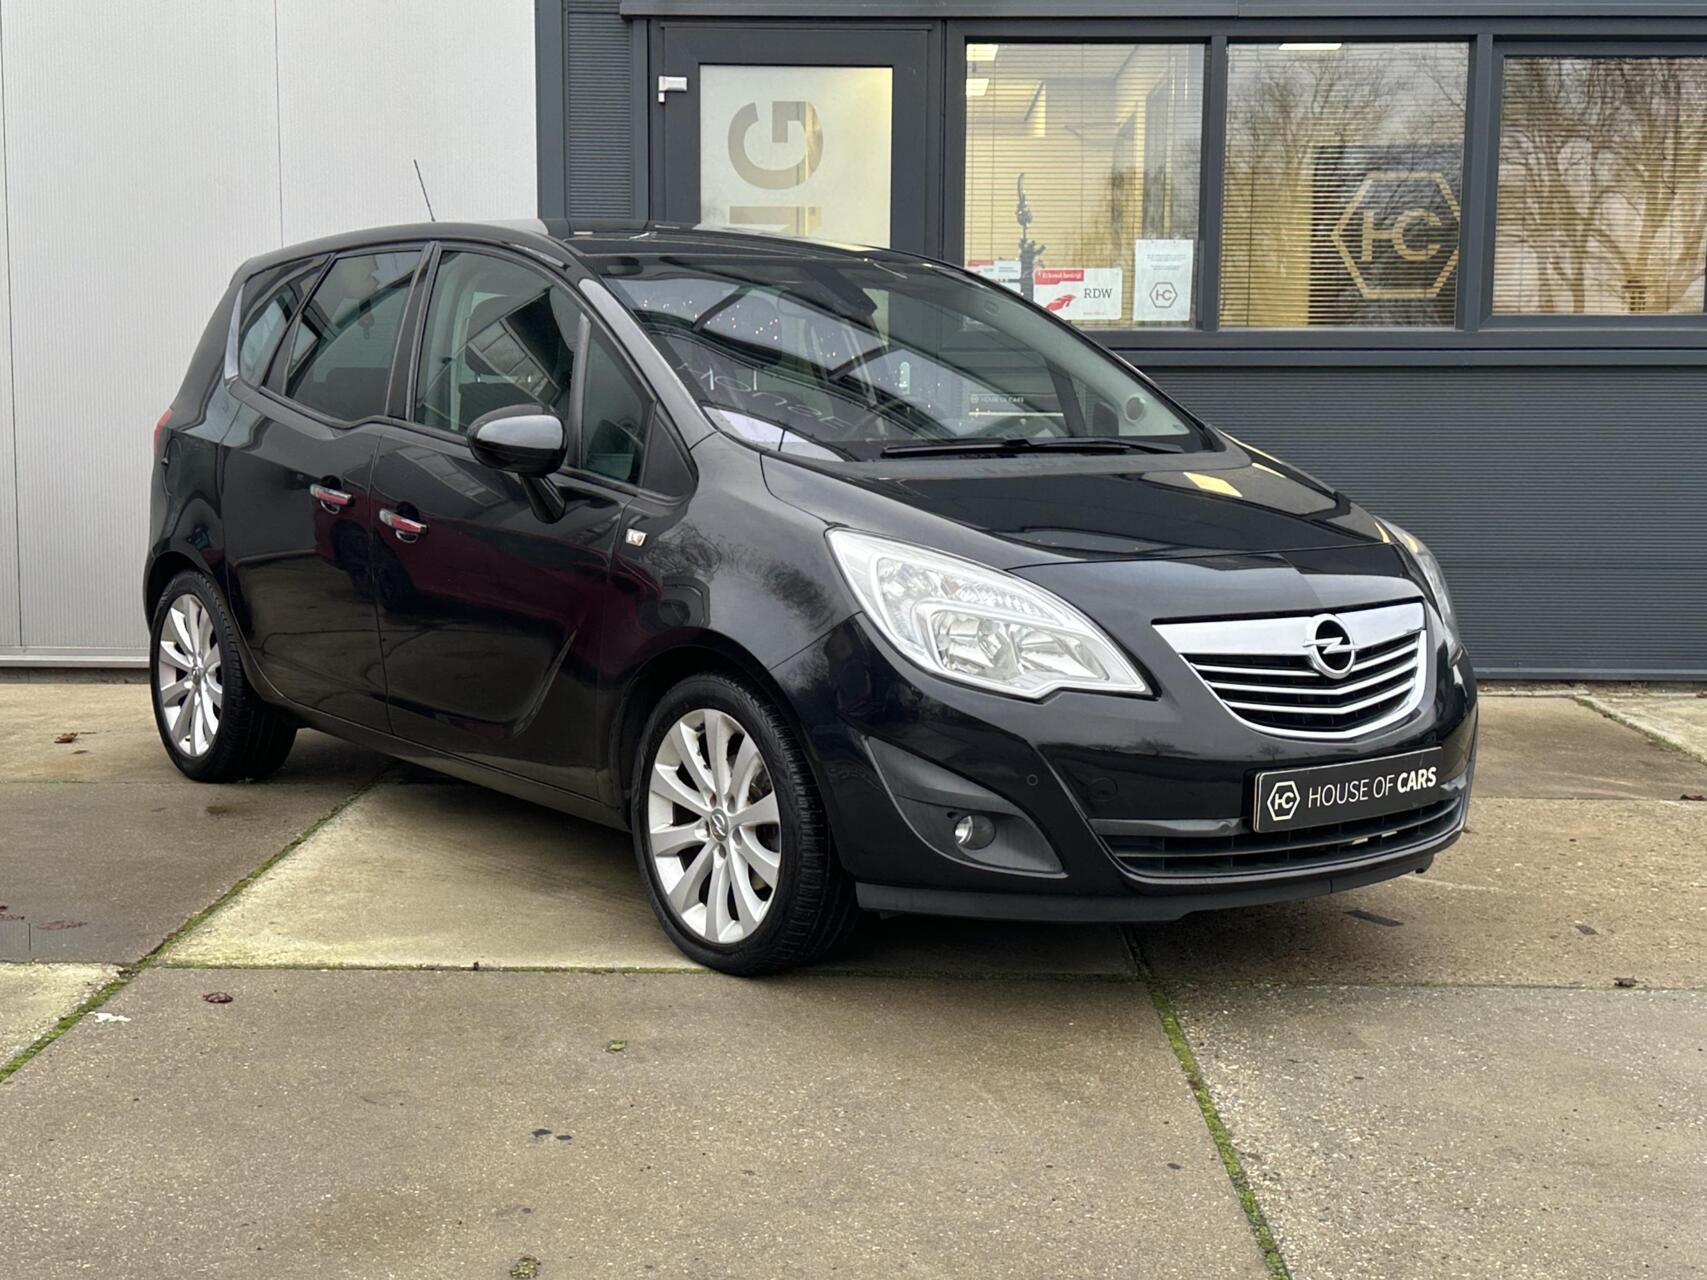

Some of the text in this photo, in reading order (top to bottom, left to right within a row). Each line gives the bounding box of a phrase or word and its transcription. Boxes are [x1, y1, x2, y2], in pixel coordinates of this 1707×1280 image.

[1084, 288, 1113, 299] RDW
[1308, 779, 1369, 808] HOUSE
[1373, 774, 1395, 798] OF
[1397, 766, 1437, 793] CARS
